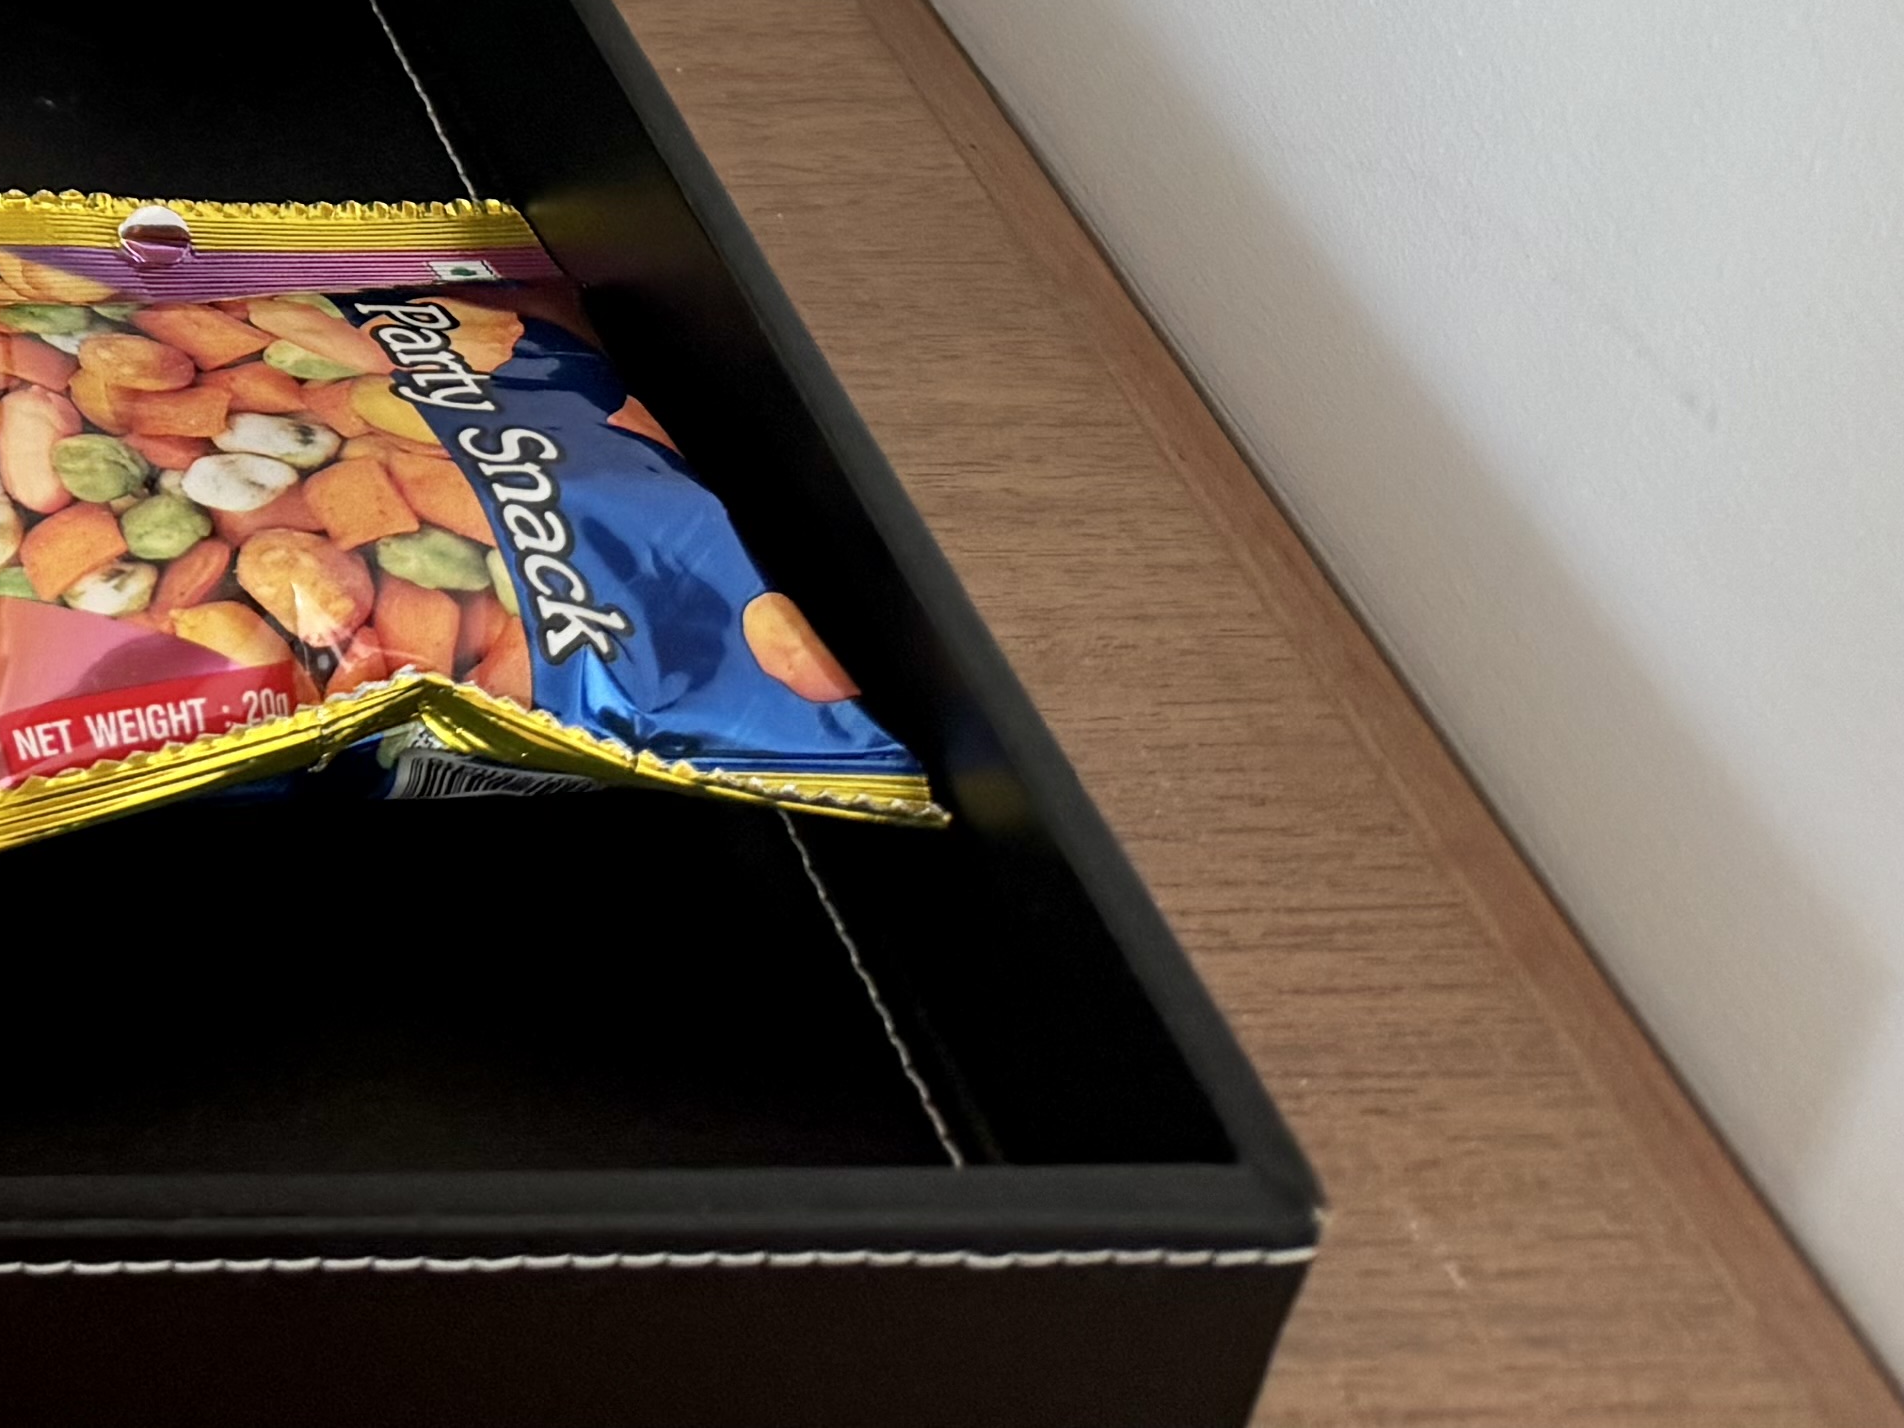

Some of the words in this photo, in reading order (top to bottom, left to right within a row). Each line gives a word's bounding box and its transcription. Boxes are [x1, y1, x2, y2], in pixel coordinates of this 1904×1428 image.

[354, 301, 495, 411] Party
[458, 427, 627, 657] Snack
[12, 719, 74, 760] NET
[88, 697, 207, 748] WEIGHT
[242, 688, 289, 724] 20g
